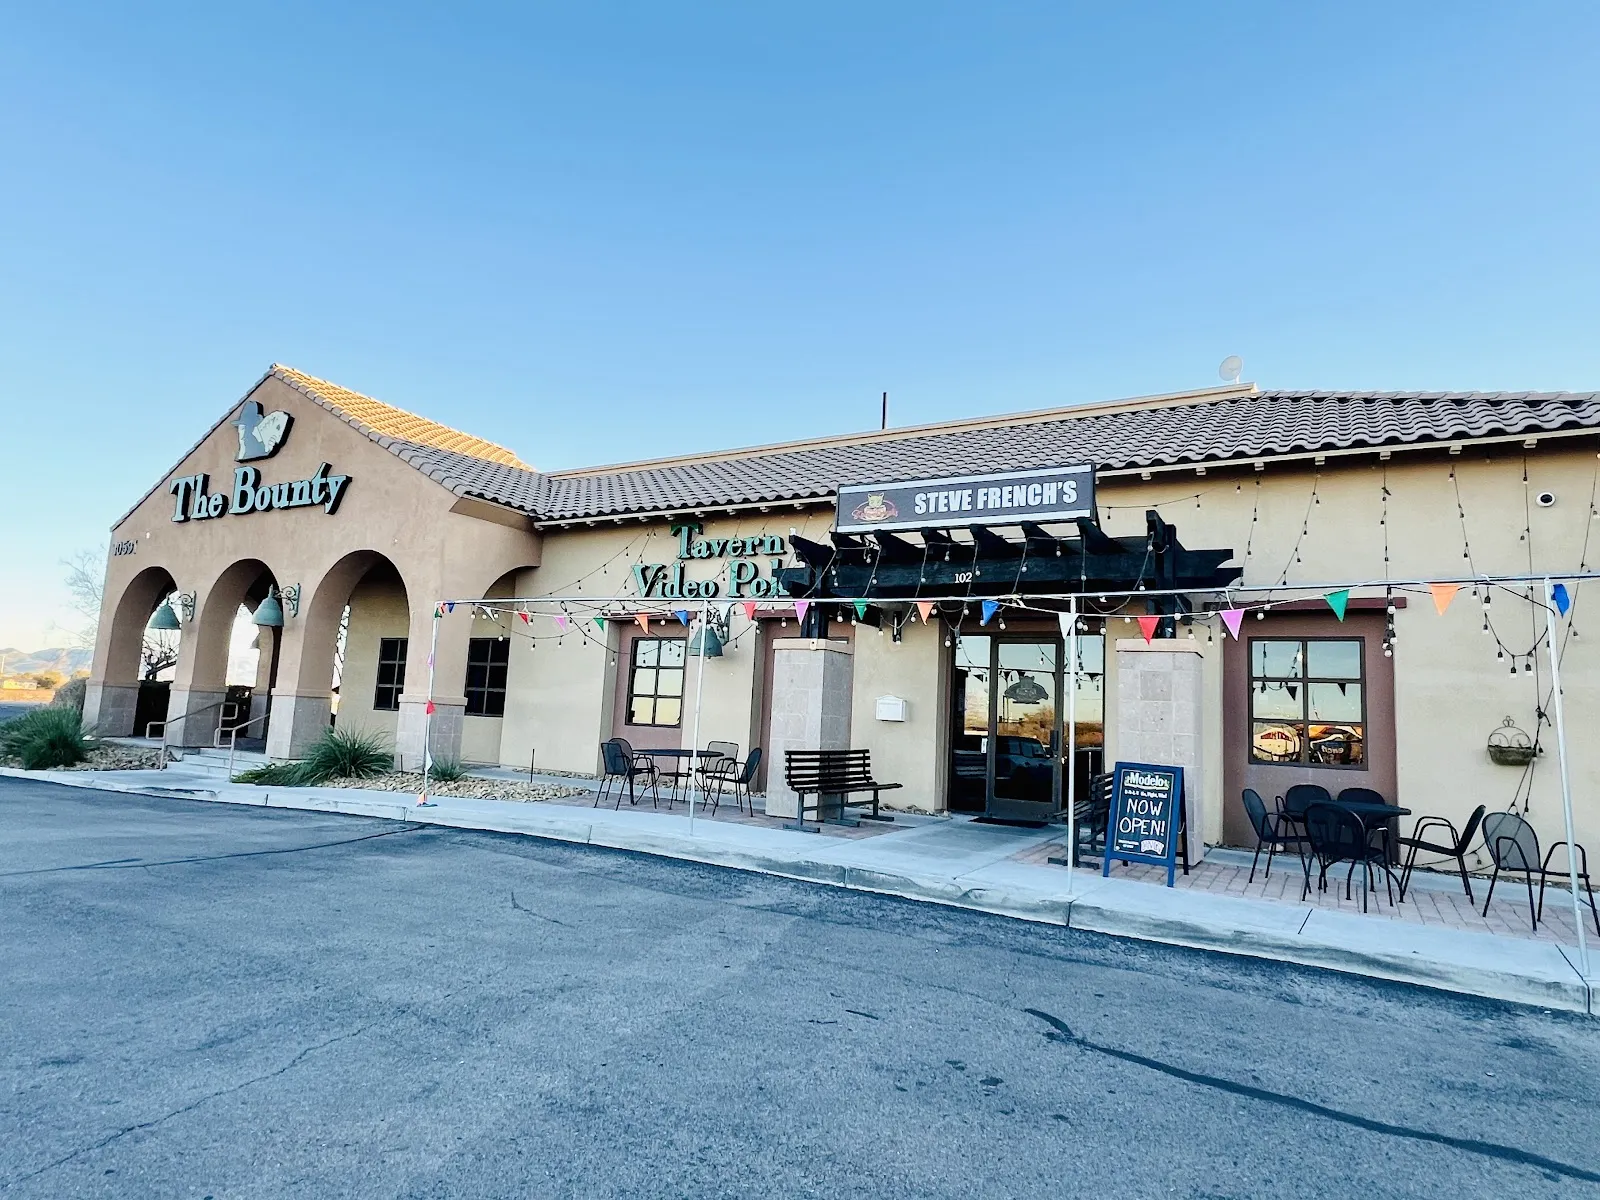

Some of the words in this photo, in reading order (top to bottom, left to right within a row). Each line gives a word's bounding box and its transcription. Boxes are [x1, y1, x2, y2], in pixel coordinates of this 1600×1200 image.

[169, 473, 228, 523] The
[228, 462, 352, 515] Bounty
[914, 489, 972, 515] STEVE
[976, 480, 1077, 510] FRENCH'S
[671, 522, 787, 559] Tavern
[631, 562, 719, 598] Video
[727, 558, 790, 598] Pok
[954, 572, 973, 583] 102
[1130, 772, 1164, 787] Modelo
[1127, 798, 1163, 816] NOW
[1119, 817, 1165, 836] OPEN!
